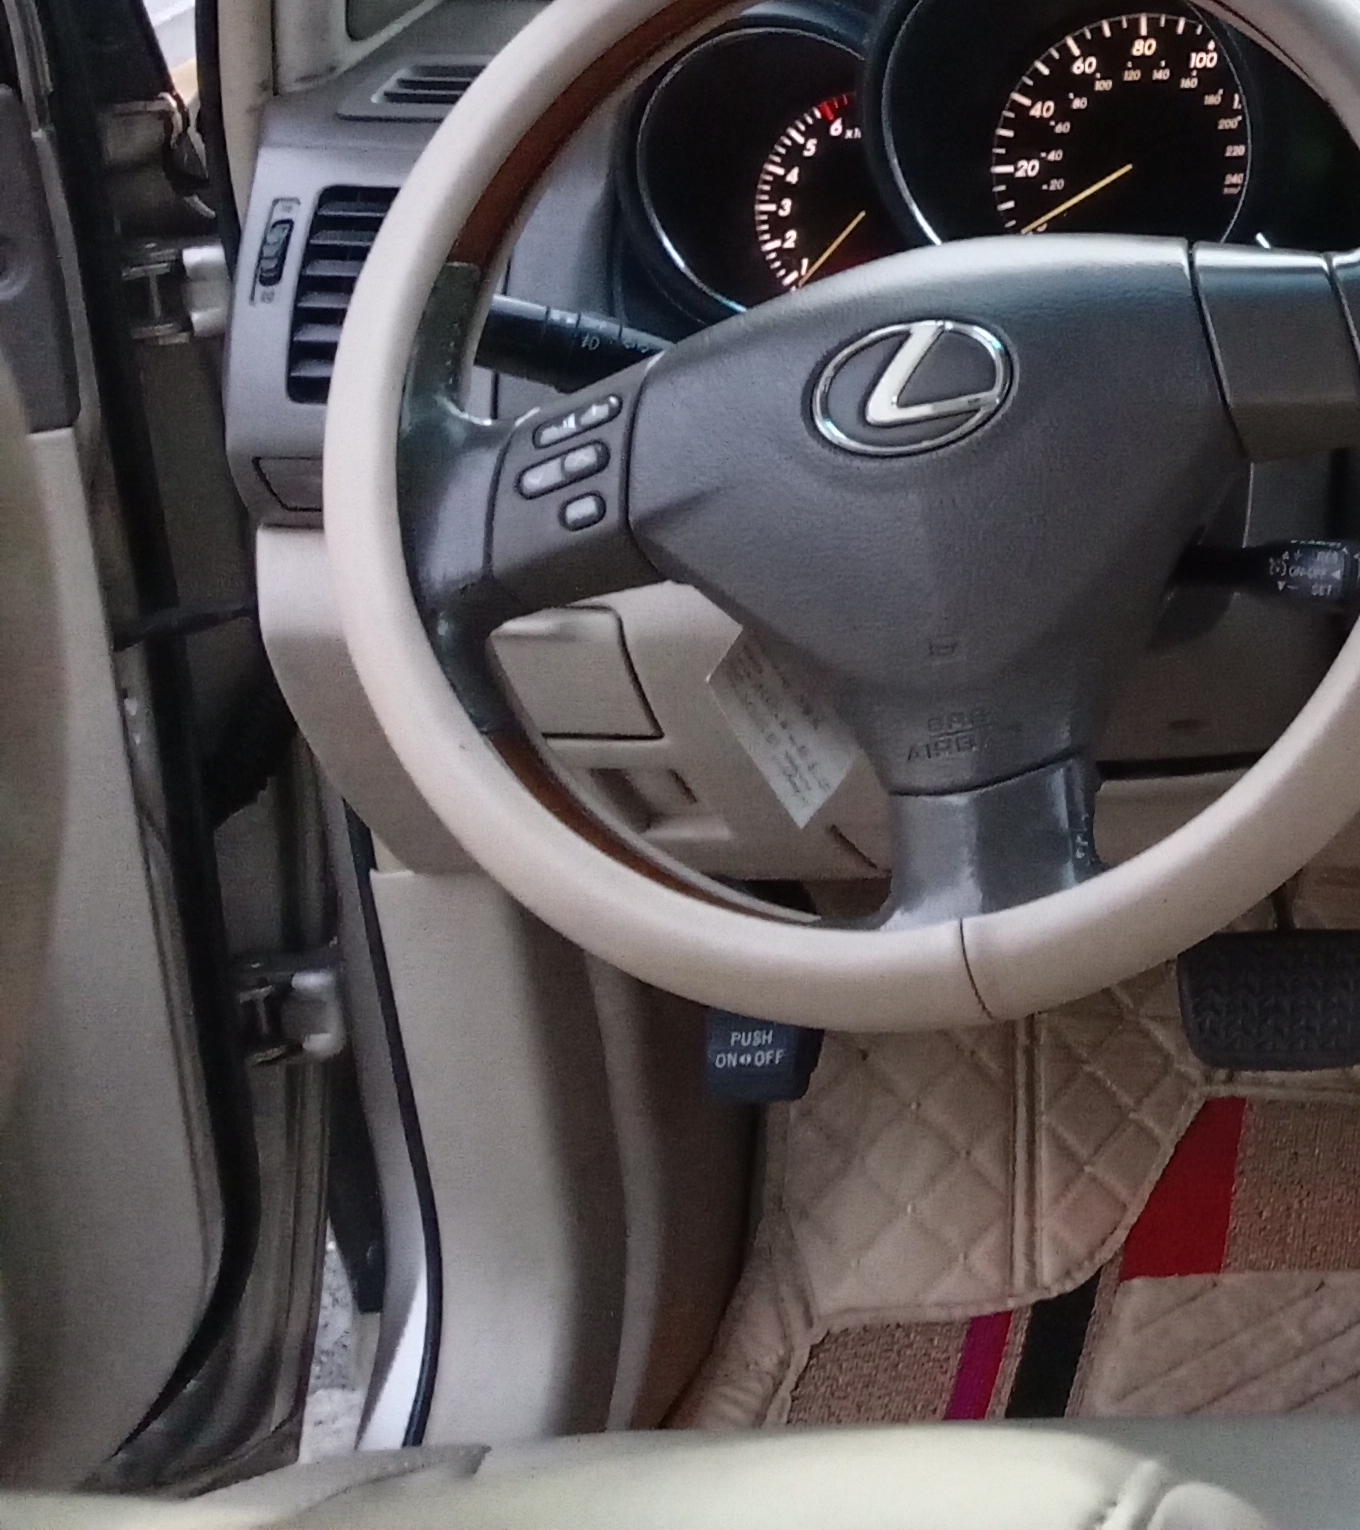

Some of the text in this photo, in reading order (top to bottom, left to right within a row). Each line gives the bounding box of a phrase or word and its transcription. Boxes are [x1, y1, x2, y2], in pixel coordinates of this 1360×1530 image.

[1131, 39, 1157, 56] 80
[1071, 57, 1098, 75] 60
[1189, 52, 1218, 69] 100
[1122, 69, 1142, 82] 120
[1152, 68, 1171, 81] 140
[1094, 80, 1113, 91] 100
[1029, 101, 1055, 119] 40
[829, 117, 843, 137] 6
[802, 138, 818, 157] 5
[1224, 144, 1246, 157] 220
[785, 167, 800, 184] 4
[1014, 160, 1039, 177] 20
[778, 198, 792, 217] 3
[782, 229, 798, 249] 2
[730, 1030, 773, 1047] PUSH
[715, 1049, 785, 1068] ON OFF
